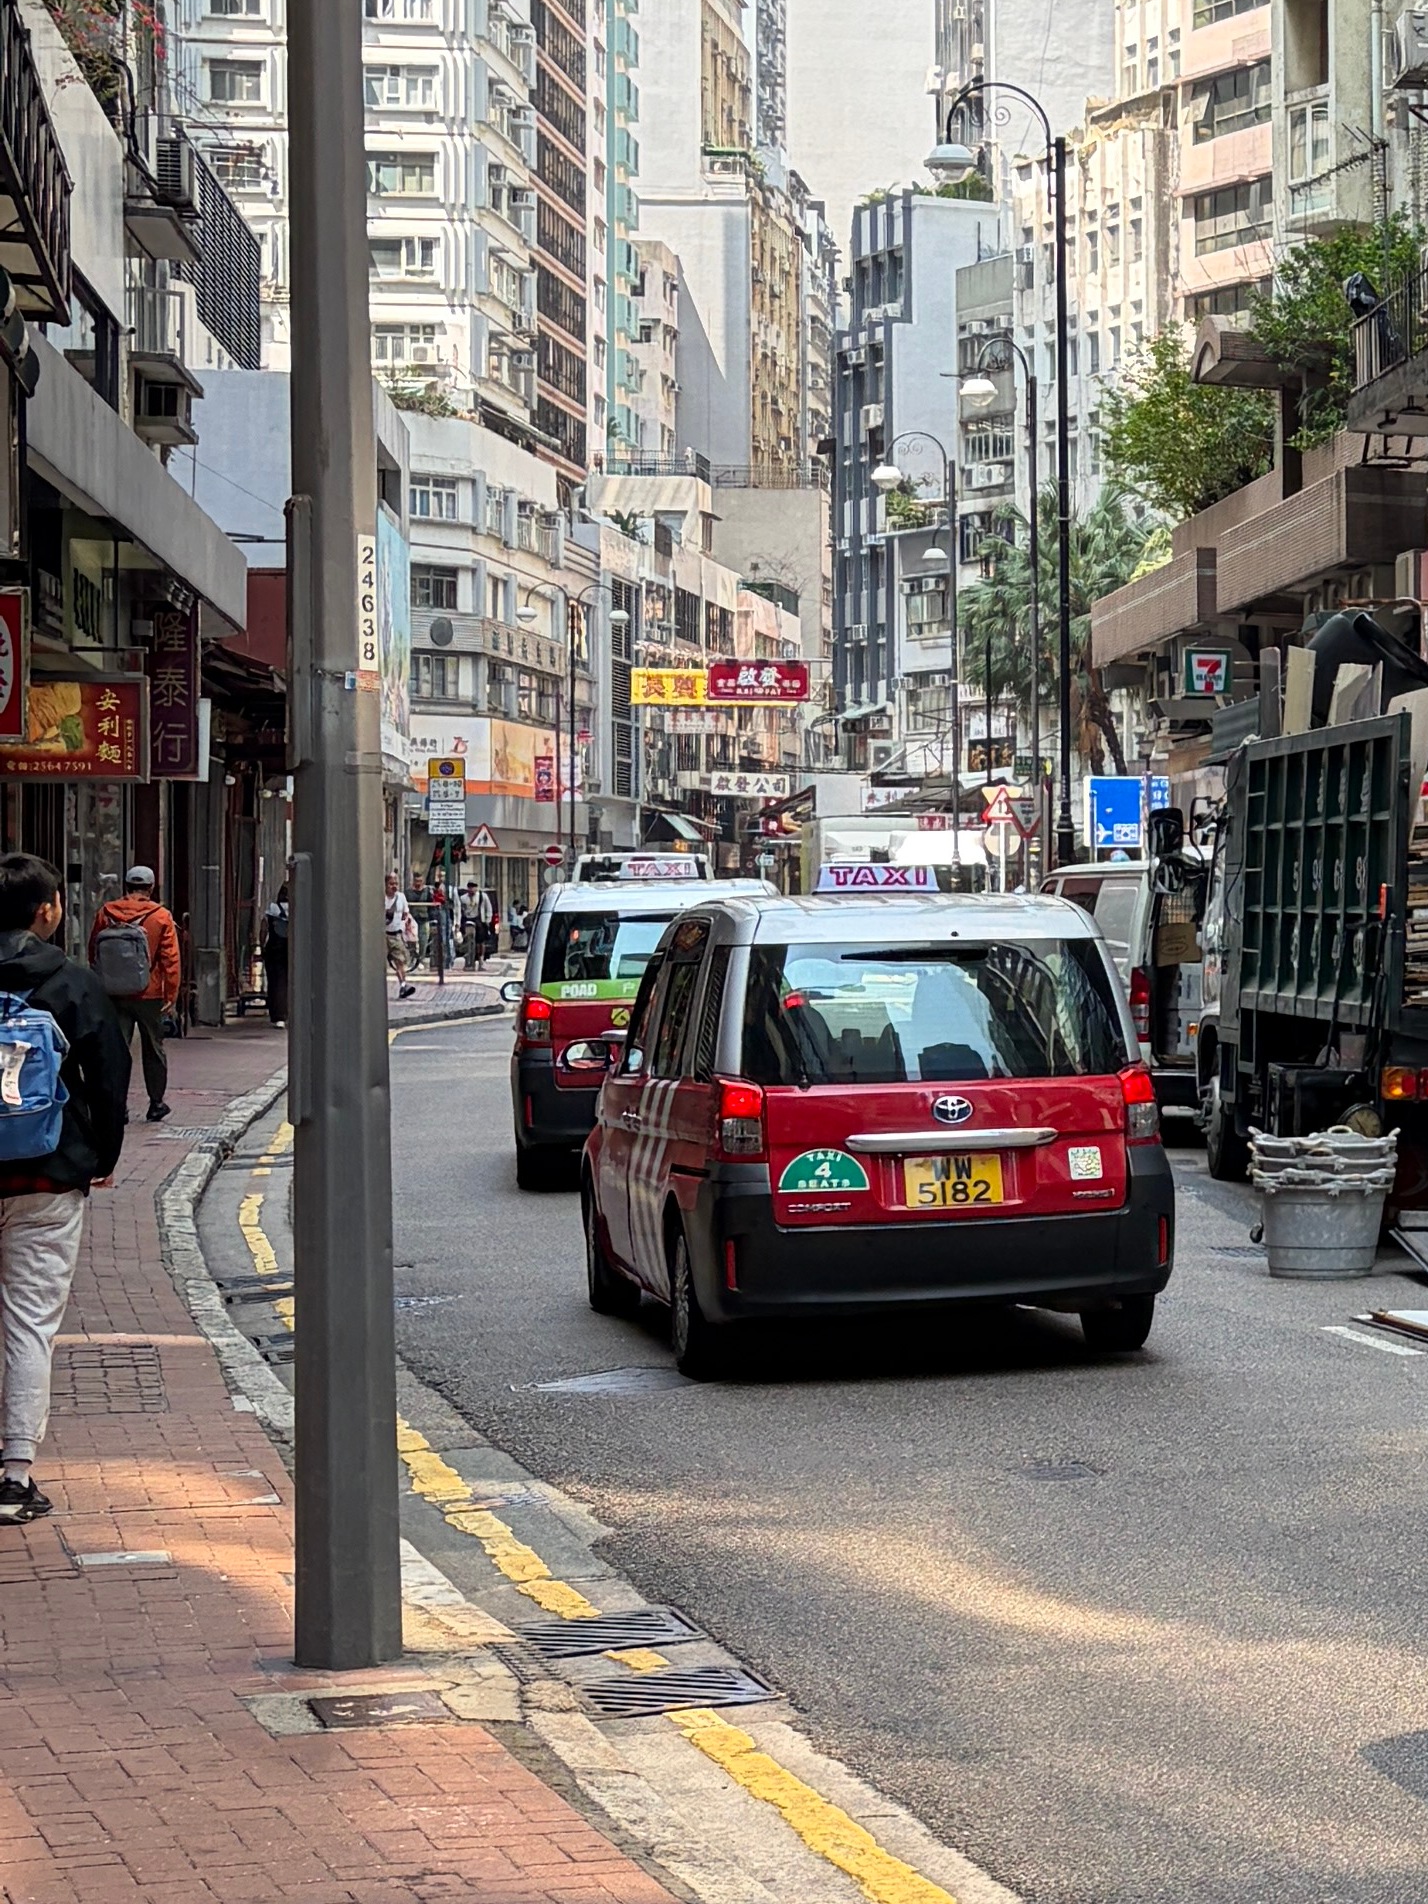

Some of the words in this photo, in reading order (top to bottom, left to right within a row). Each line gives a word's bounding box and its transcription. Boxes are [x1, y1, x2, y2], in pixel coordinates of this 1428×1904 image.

[361, 545, 376, 662] 24638
[153, 611, 189, 764] 隆泰行
[628, 861, 691, 876] TAXI
[829, 866, 928, 886] TAXI
[561, 983, 597, 998] POAD
[806, 1150, 842, 1162] TAXI
[814, 1162, 832, 1178] 4
[798, 1179, 850, 1188] SEATS
[918, 1180, 992, 1205] 5182
